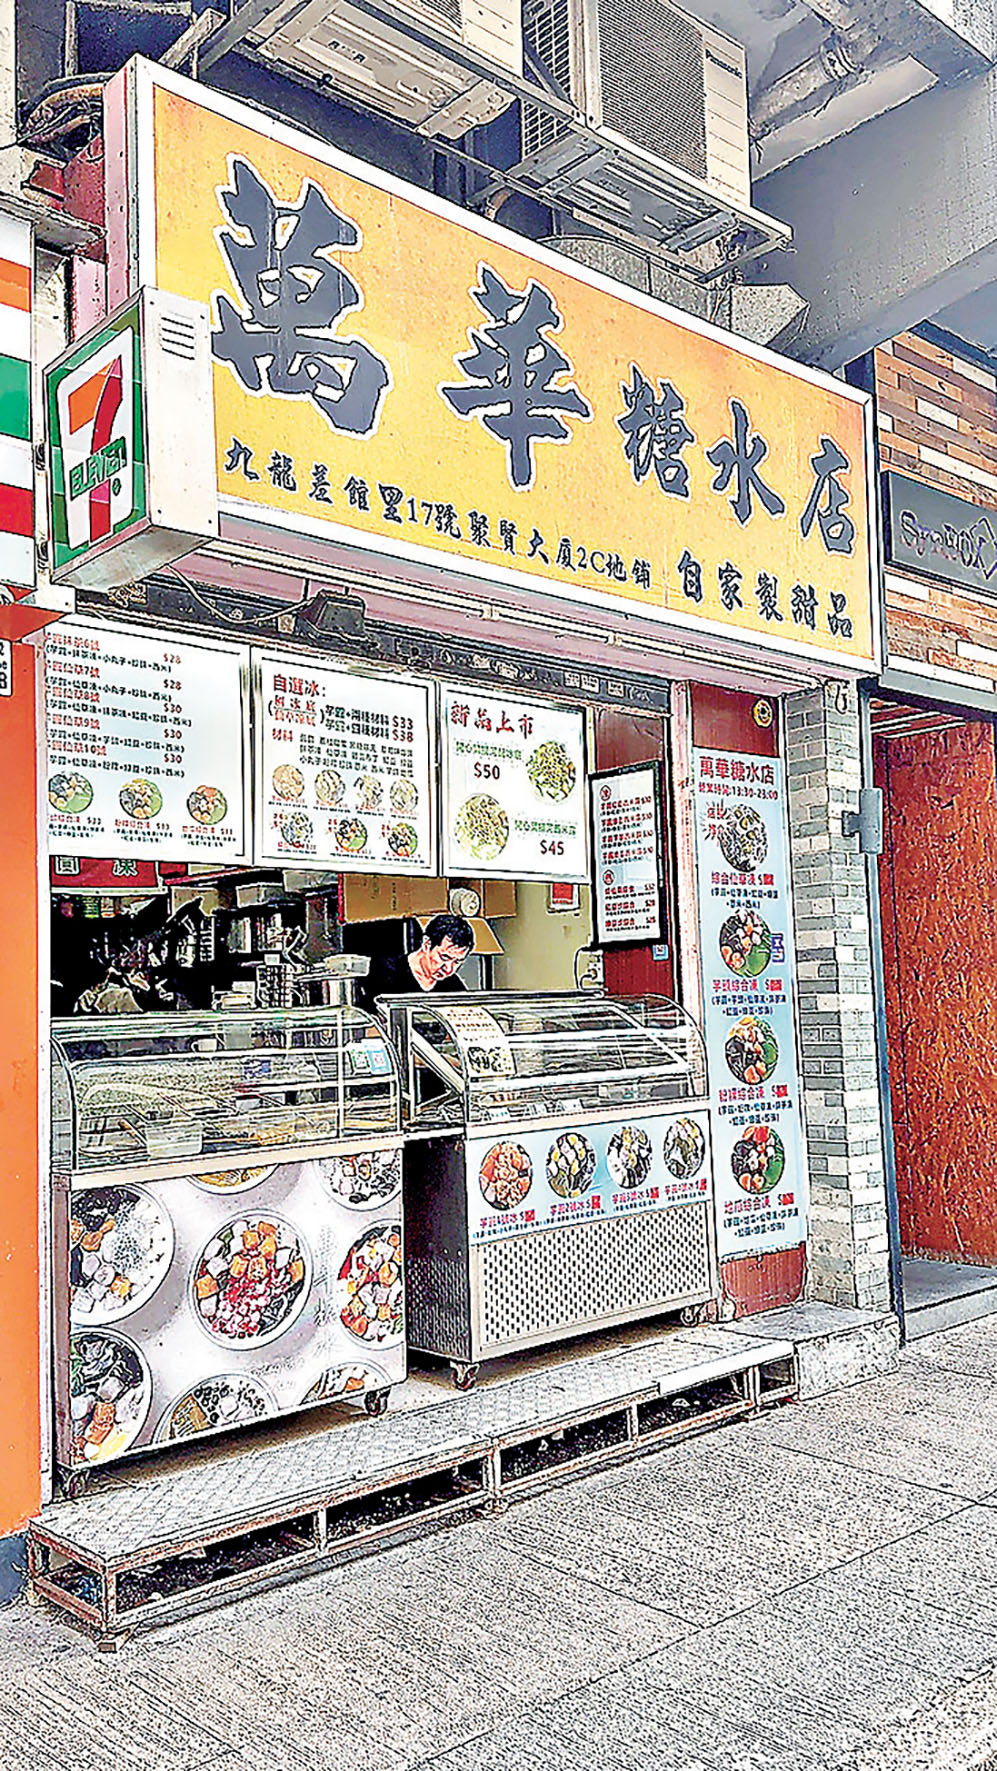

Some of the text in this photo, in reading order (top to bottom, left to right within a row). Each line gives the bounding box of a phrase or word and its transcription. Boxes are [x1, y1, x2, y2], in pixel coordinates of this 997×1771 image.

[210, 157, 856, 554] 萬華糖水店
[678, 550, 853, 638] 自家製甜品
[163, 653, 181, 664] $28
[163, 679, 182, 690] $28
[273, 674, 326, 697] 自選冰:
[164, 702, 182, 714] $30
[392, 715, 414, 730] $33
[451, 701, 534, 739] 新品上市
[164, 729, 182, 740] $30
[392, 729, 414, 743] $38
[164, 753, 182, 764] $30
[474, 762, 500, 780] $50
[699, 755, 775, 786] 萬華糖水店
[540, 839, 565, 855] $45
